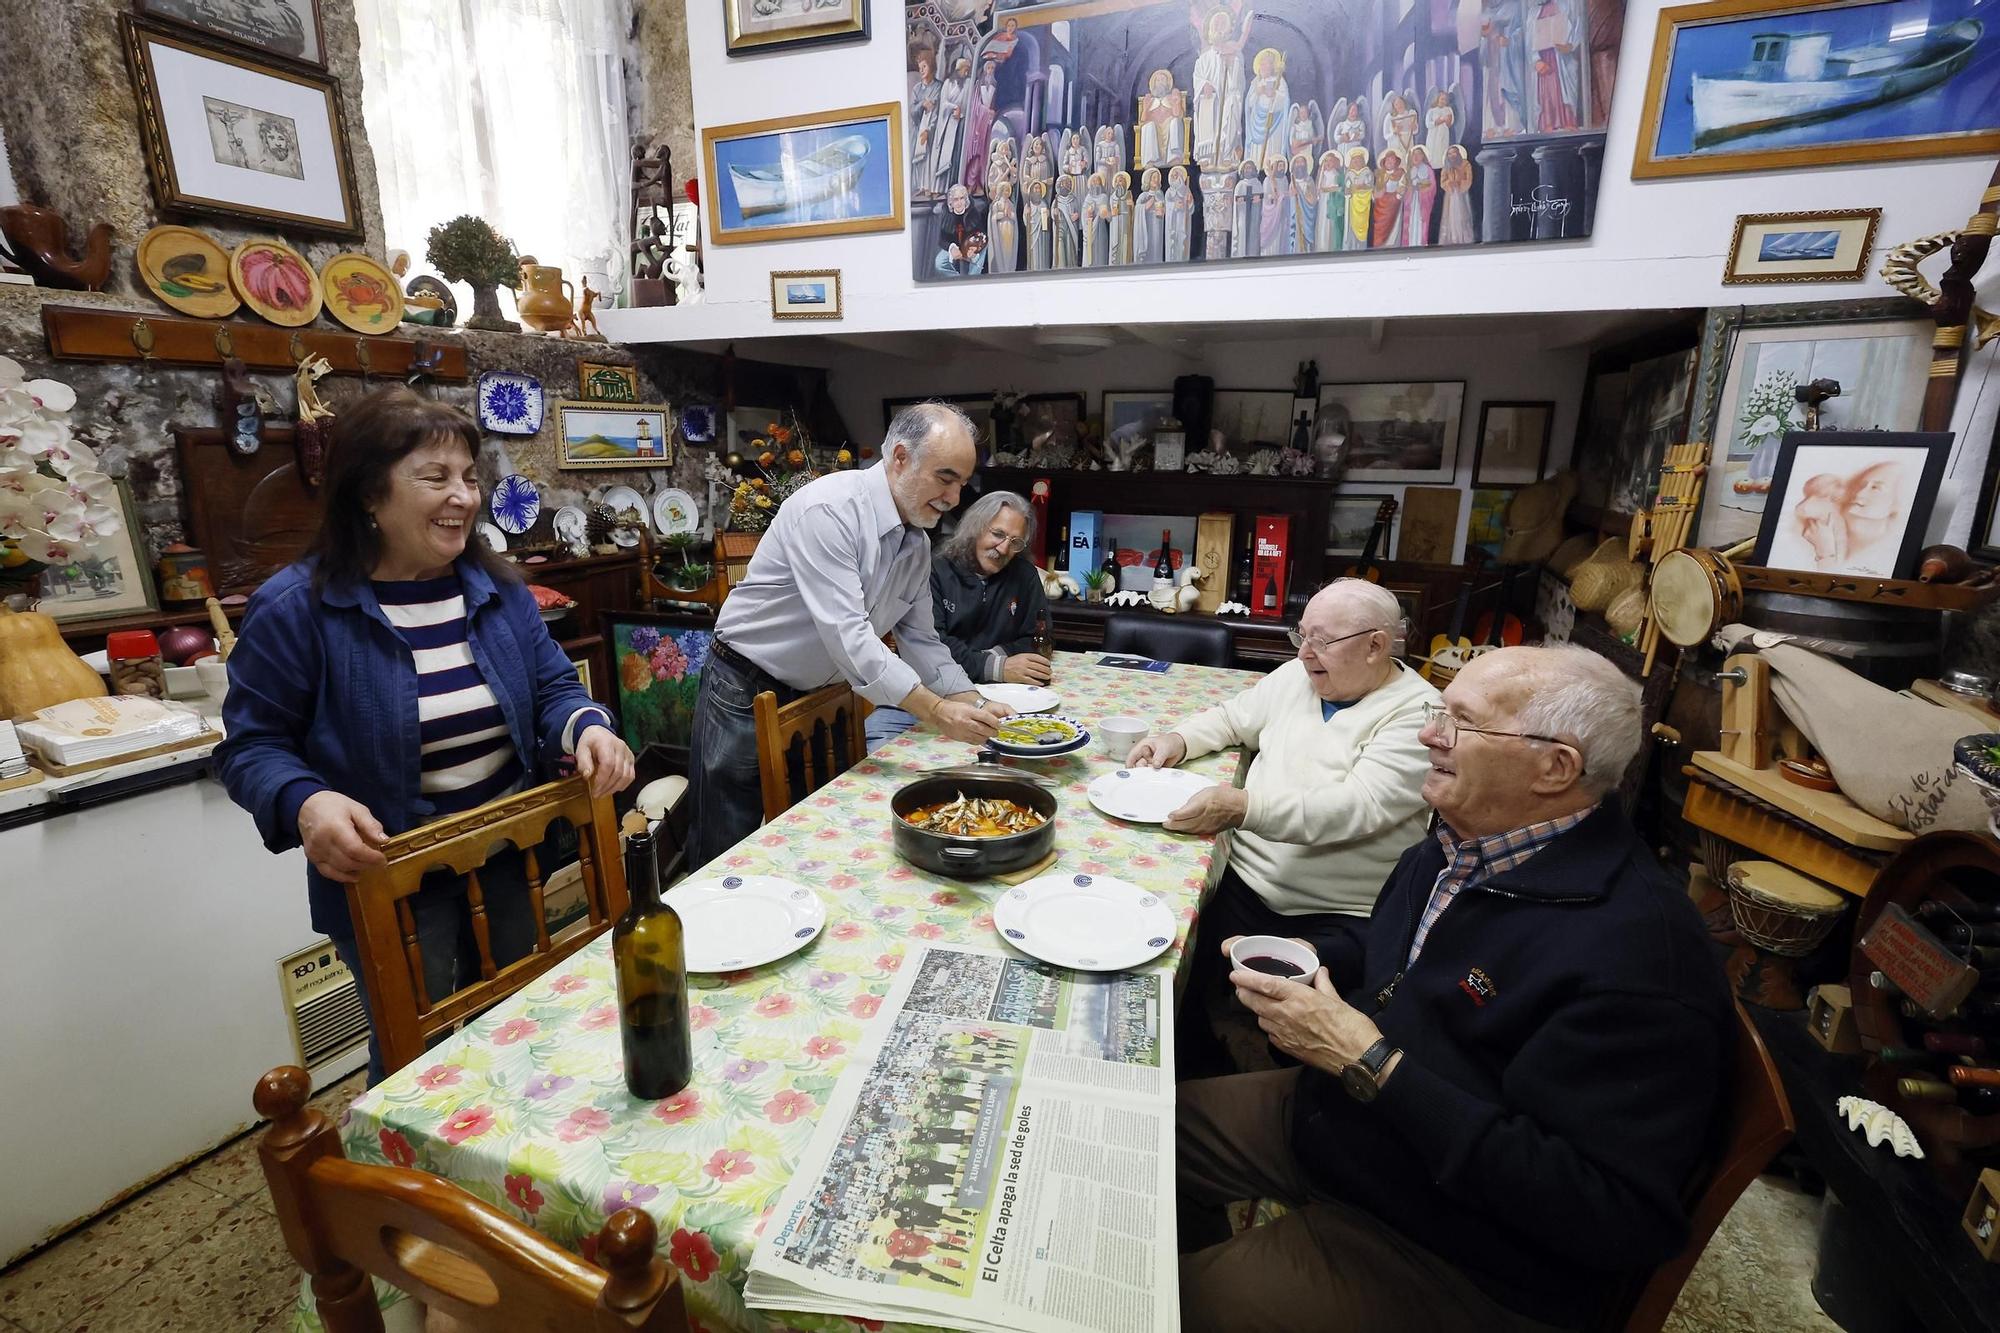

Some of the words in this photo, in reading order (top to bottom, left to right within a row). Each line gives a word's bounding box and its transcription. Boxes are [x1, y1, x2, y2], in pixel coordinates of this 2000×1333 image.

[292, 961, 315, 979] 180
[1017, 1105, 1032, 1133] goles
[969, 1149, 984, 1181] XUNTOS
[978, 1115, 991, 1147] CONTRA
[987, 1088, 998, 1106] LUME
[1011, 1133, 1024, 1149] de
[1009, 1149, 1022, 1171] sed
[1003, 1172, 1018, 1183] la
[999, 1185, 1016, 1225] apaga
[773, 1199, 807, 1246] Deportes
[987, 1229, 1007, 1265] Celta
[982, 1267, 998, 1282] El
